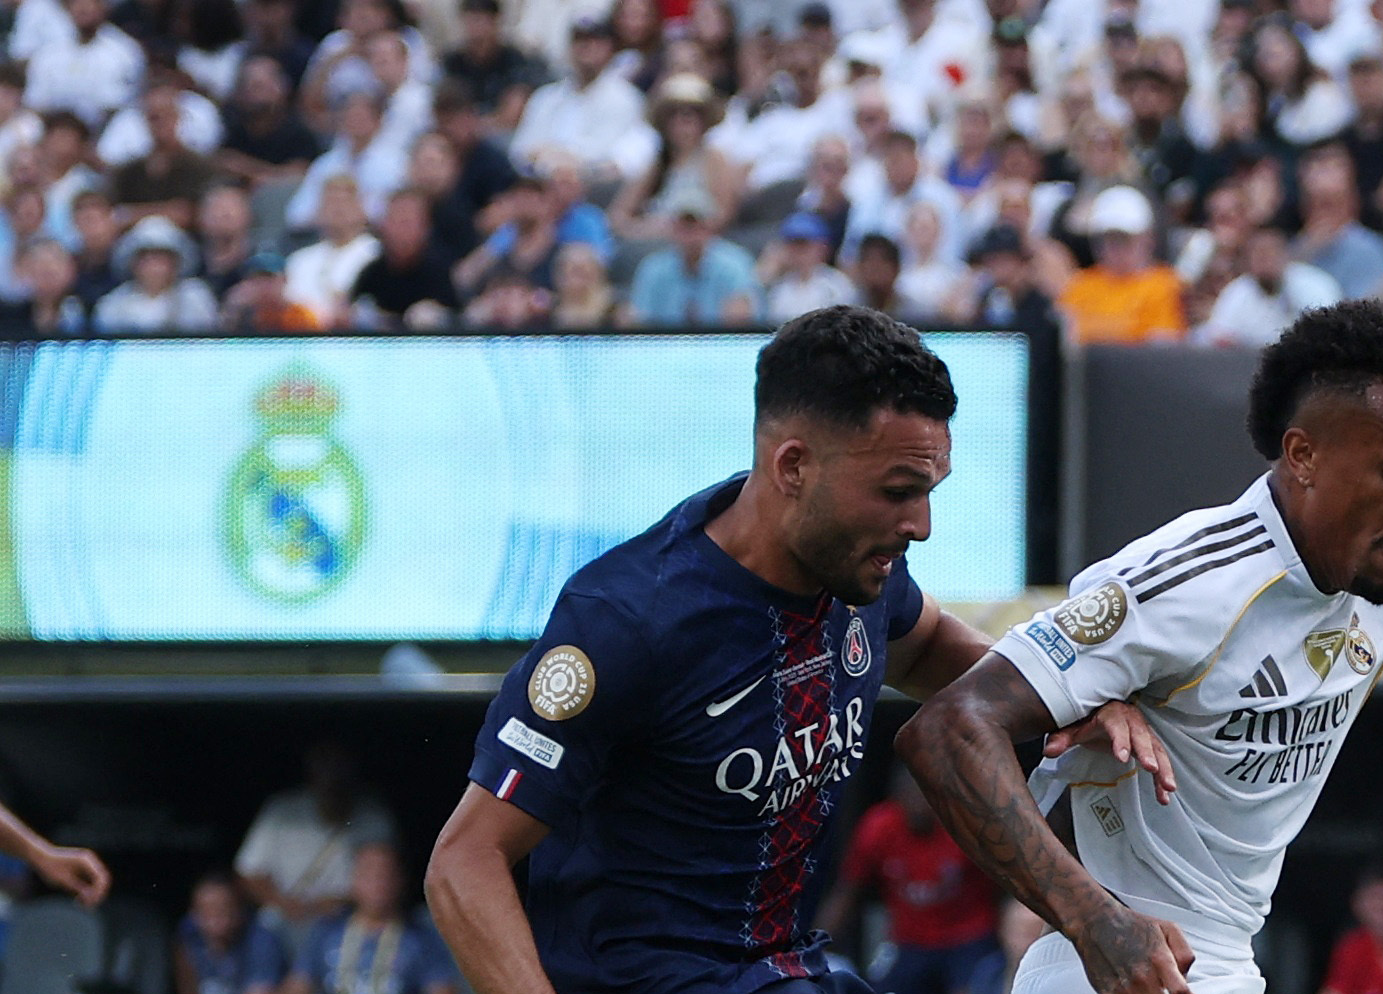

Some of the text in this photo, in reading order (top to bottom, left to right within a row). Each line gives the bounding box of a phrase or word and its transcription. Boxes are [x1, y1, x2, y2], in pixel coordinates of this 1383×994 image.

[1058, 611, 1078, 636] FIFA
[1084, 628, 1104, 638] USA
[546, 653, 576, 666] WORLD
[534, 666, 547, 691] CLUB
[574, 661, 588, 680] CUP
[534, 695, 556, 716] FIFA
[562, 696, 582, 711] USA
[715, 696, 864, 802] QATAR
